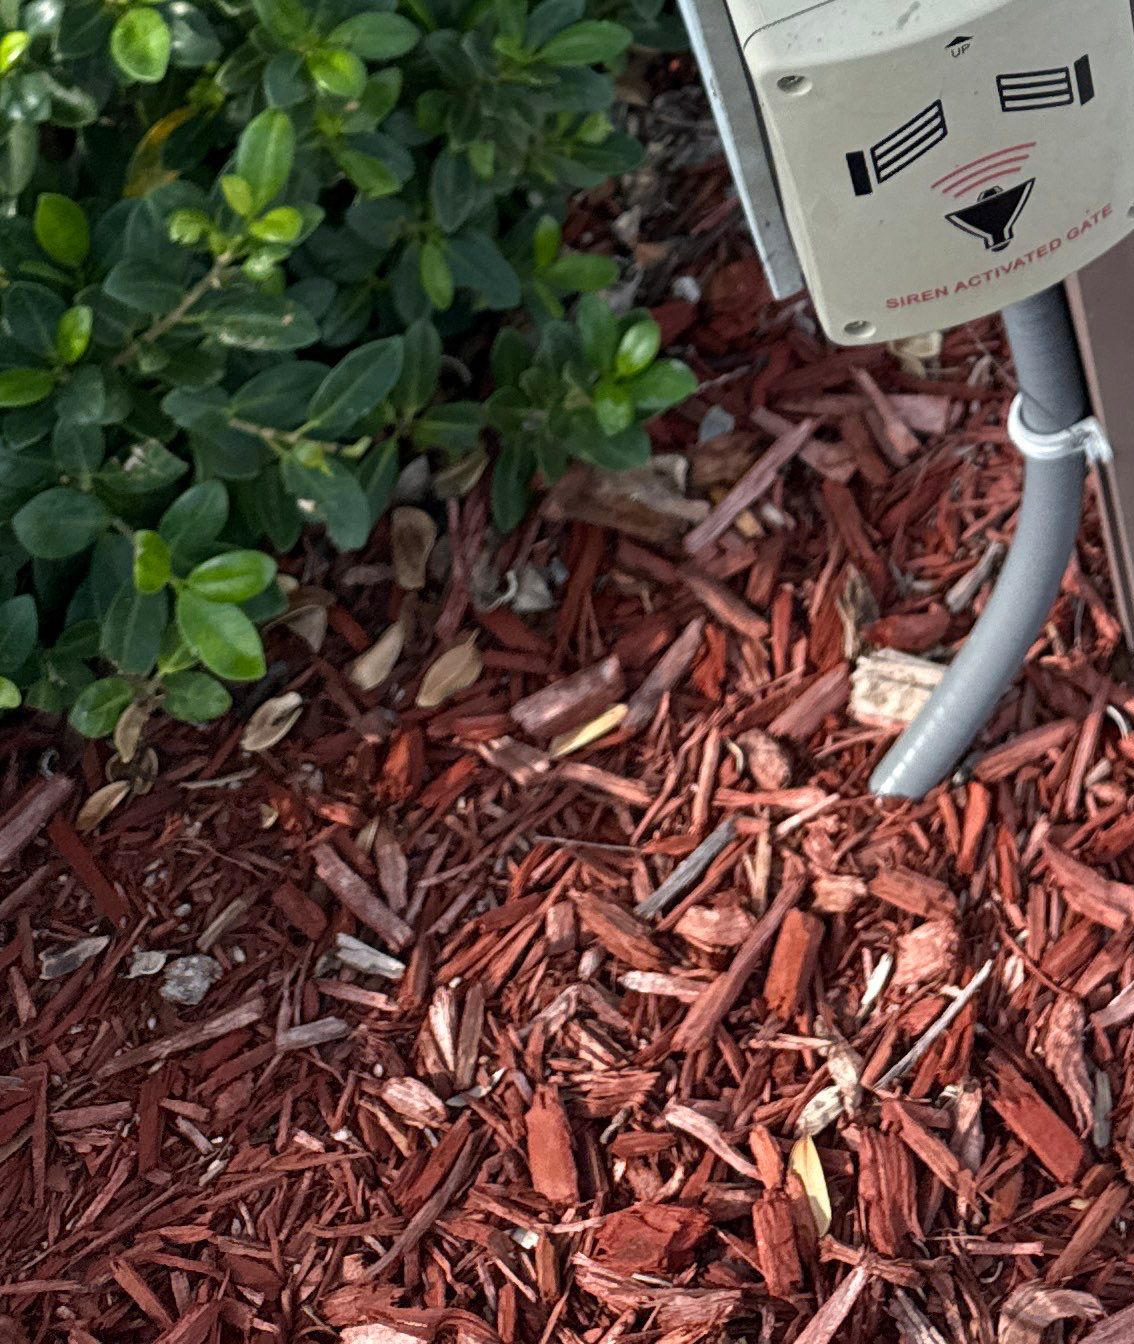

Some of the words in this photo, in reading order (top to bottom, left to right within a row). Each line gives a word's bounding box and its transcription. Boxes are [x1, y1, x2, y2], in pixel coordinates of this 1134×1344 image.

[950, 43, 971, 58] UP
[886, 285, 949, 309] SIREN
[954, 238, 1061, 293] ACTIVATED
[1066, 203, 1113, 241] GATE
